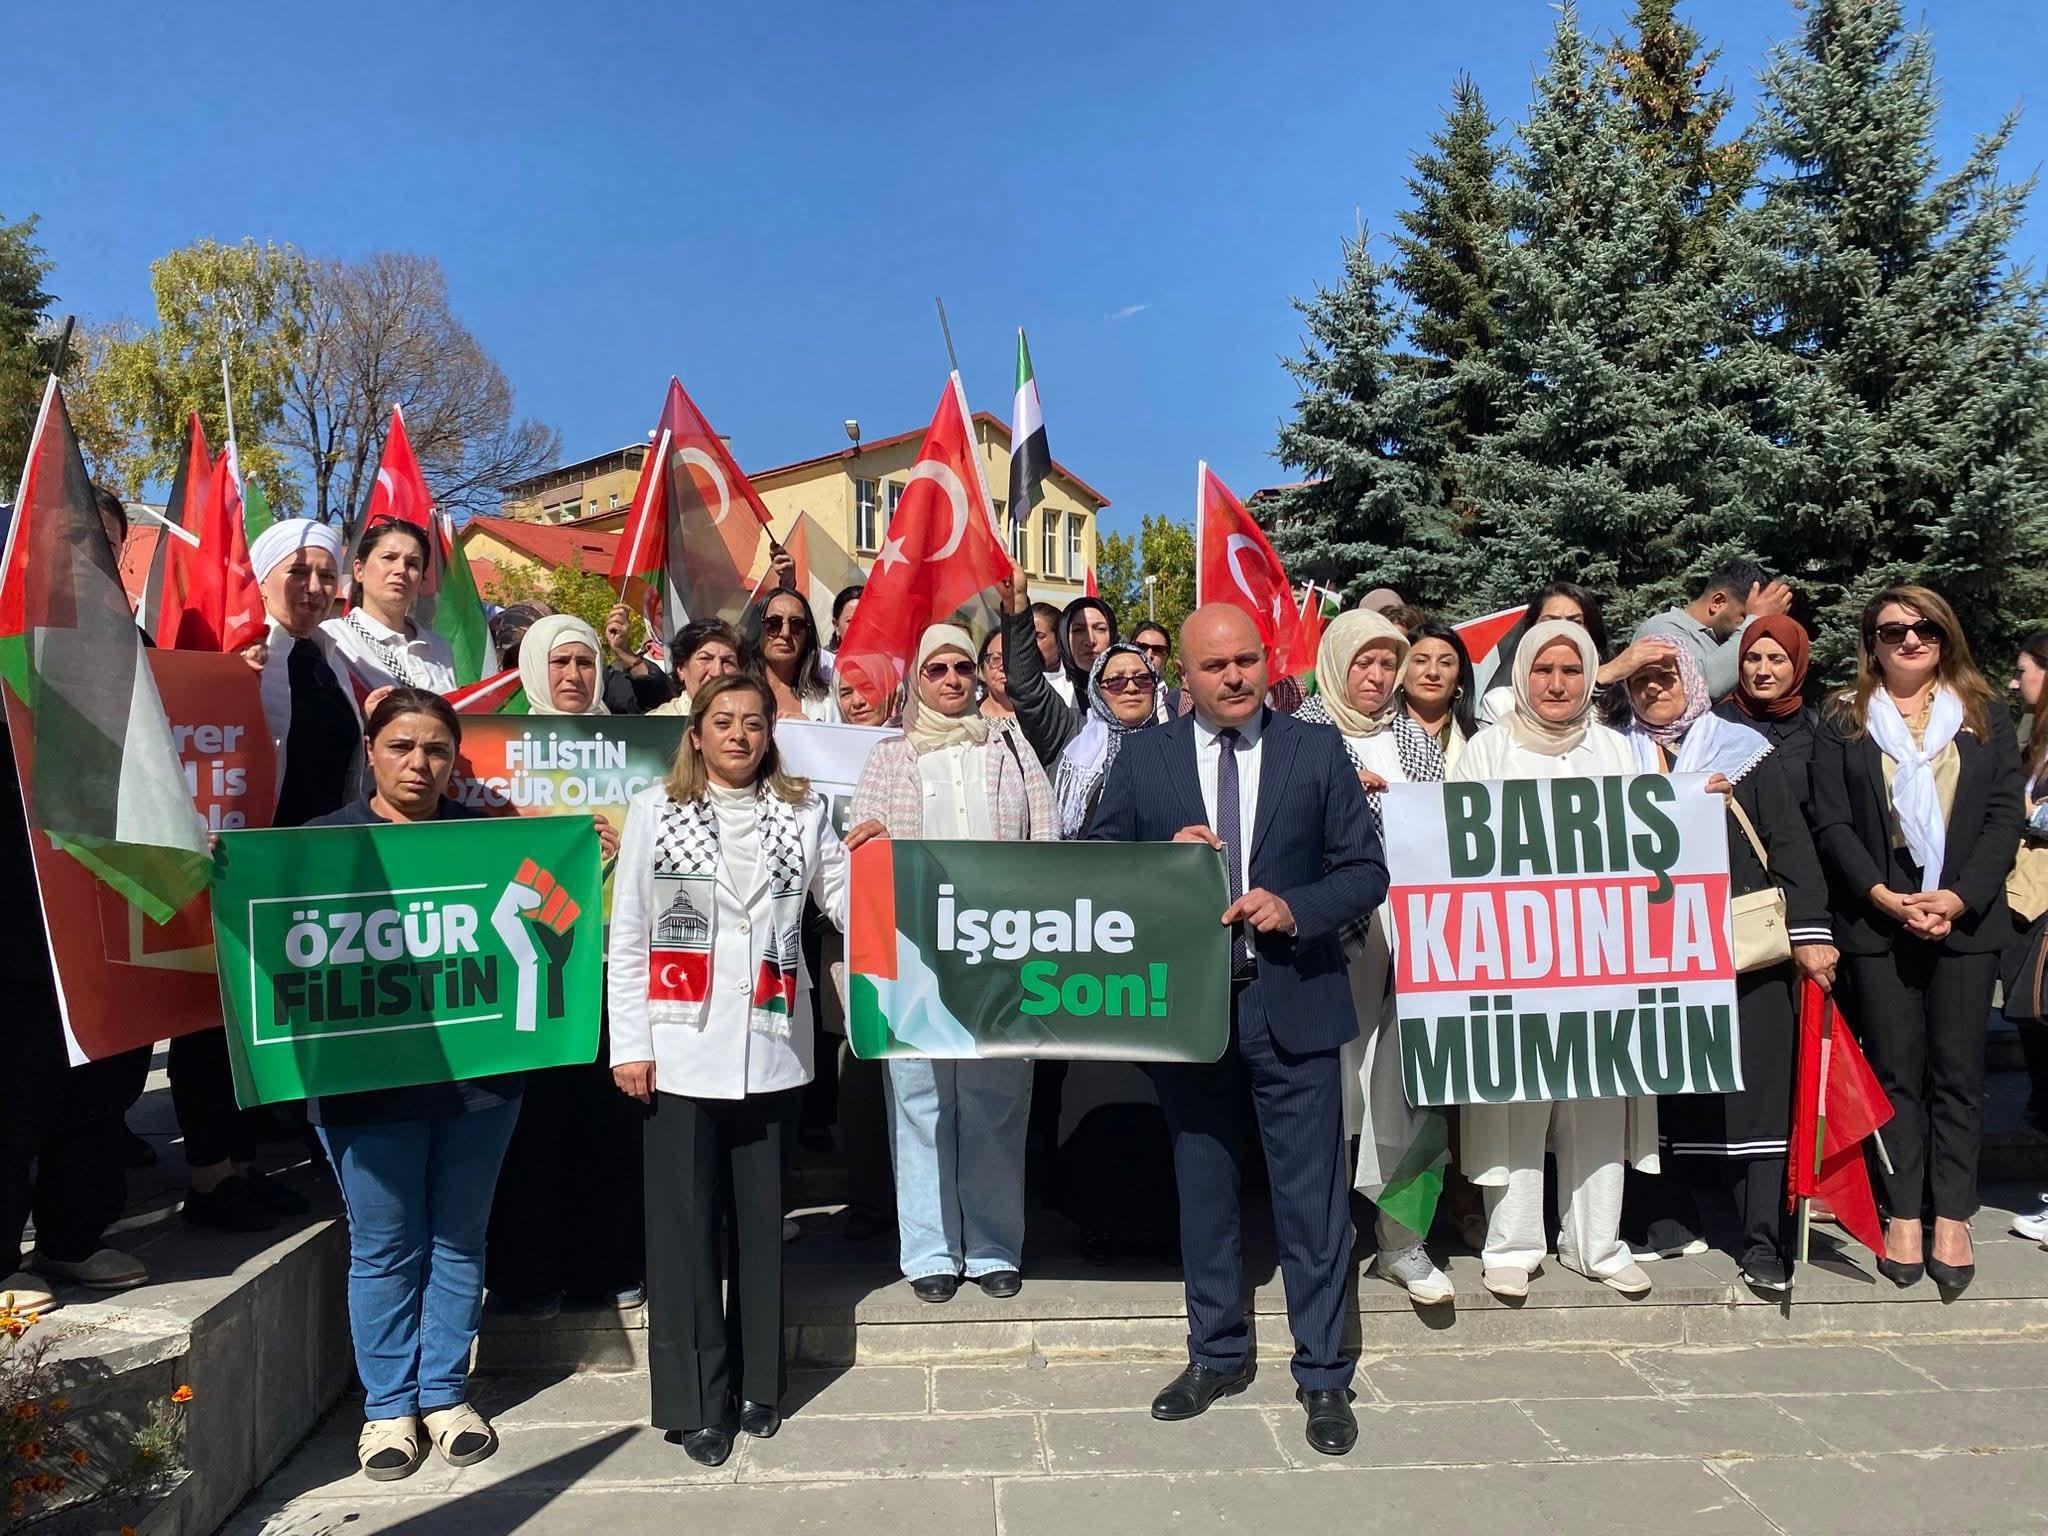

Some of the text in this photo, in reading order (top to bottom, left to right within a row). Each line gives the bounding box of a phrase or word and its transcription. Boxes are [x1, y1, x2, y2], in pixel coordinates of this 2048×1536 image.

[211, 760, 248, 796] is
[505, 732, 627, 769] FİLİSTİN
[560, 776, 664, 808] OLAC
[1442, 773, 1681, 904] BARIŞ
[285, 901, 480, 968] ÖZGÜR
[937, 883, 1135, 965] İşgale
[1407, 883, 1717, 983] KADINLA
[1020, 960, 1168, 1016] Son!
[1400, 987, 1738, 1106] MÜMKÜN
